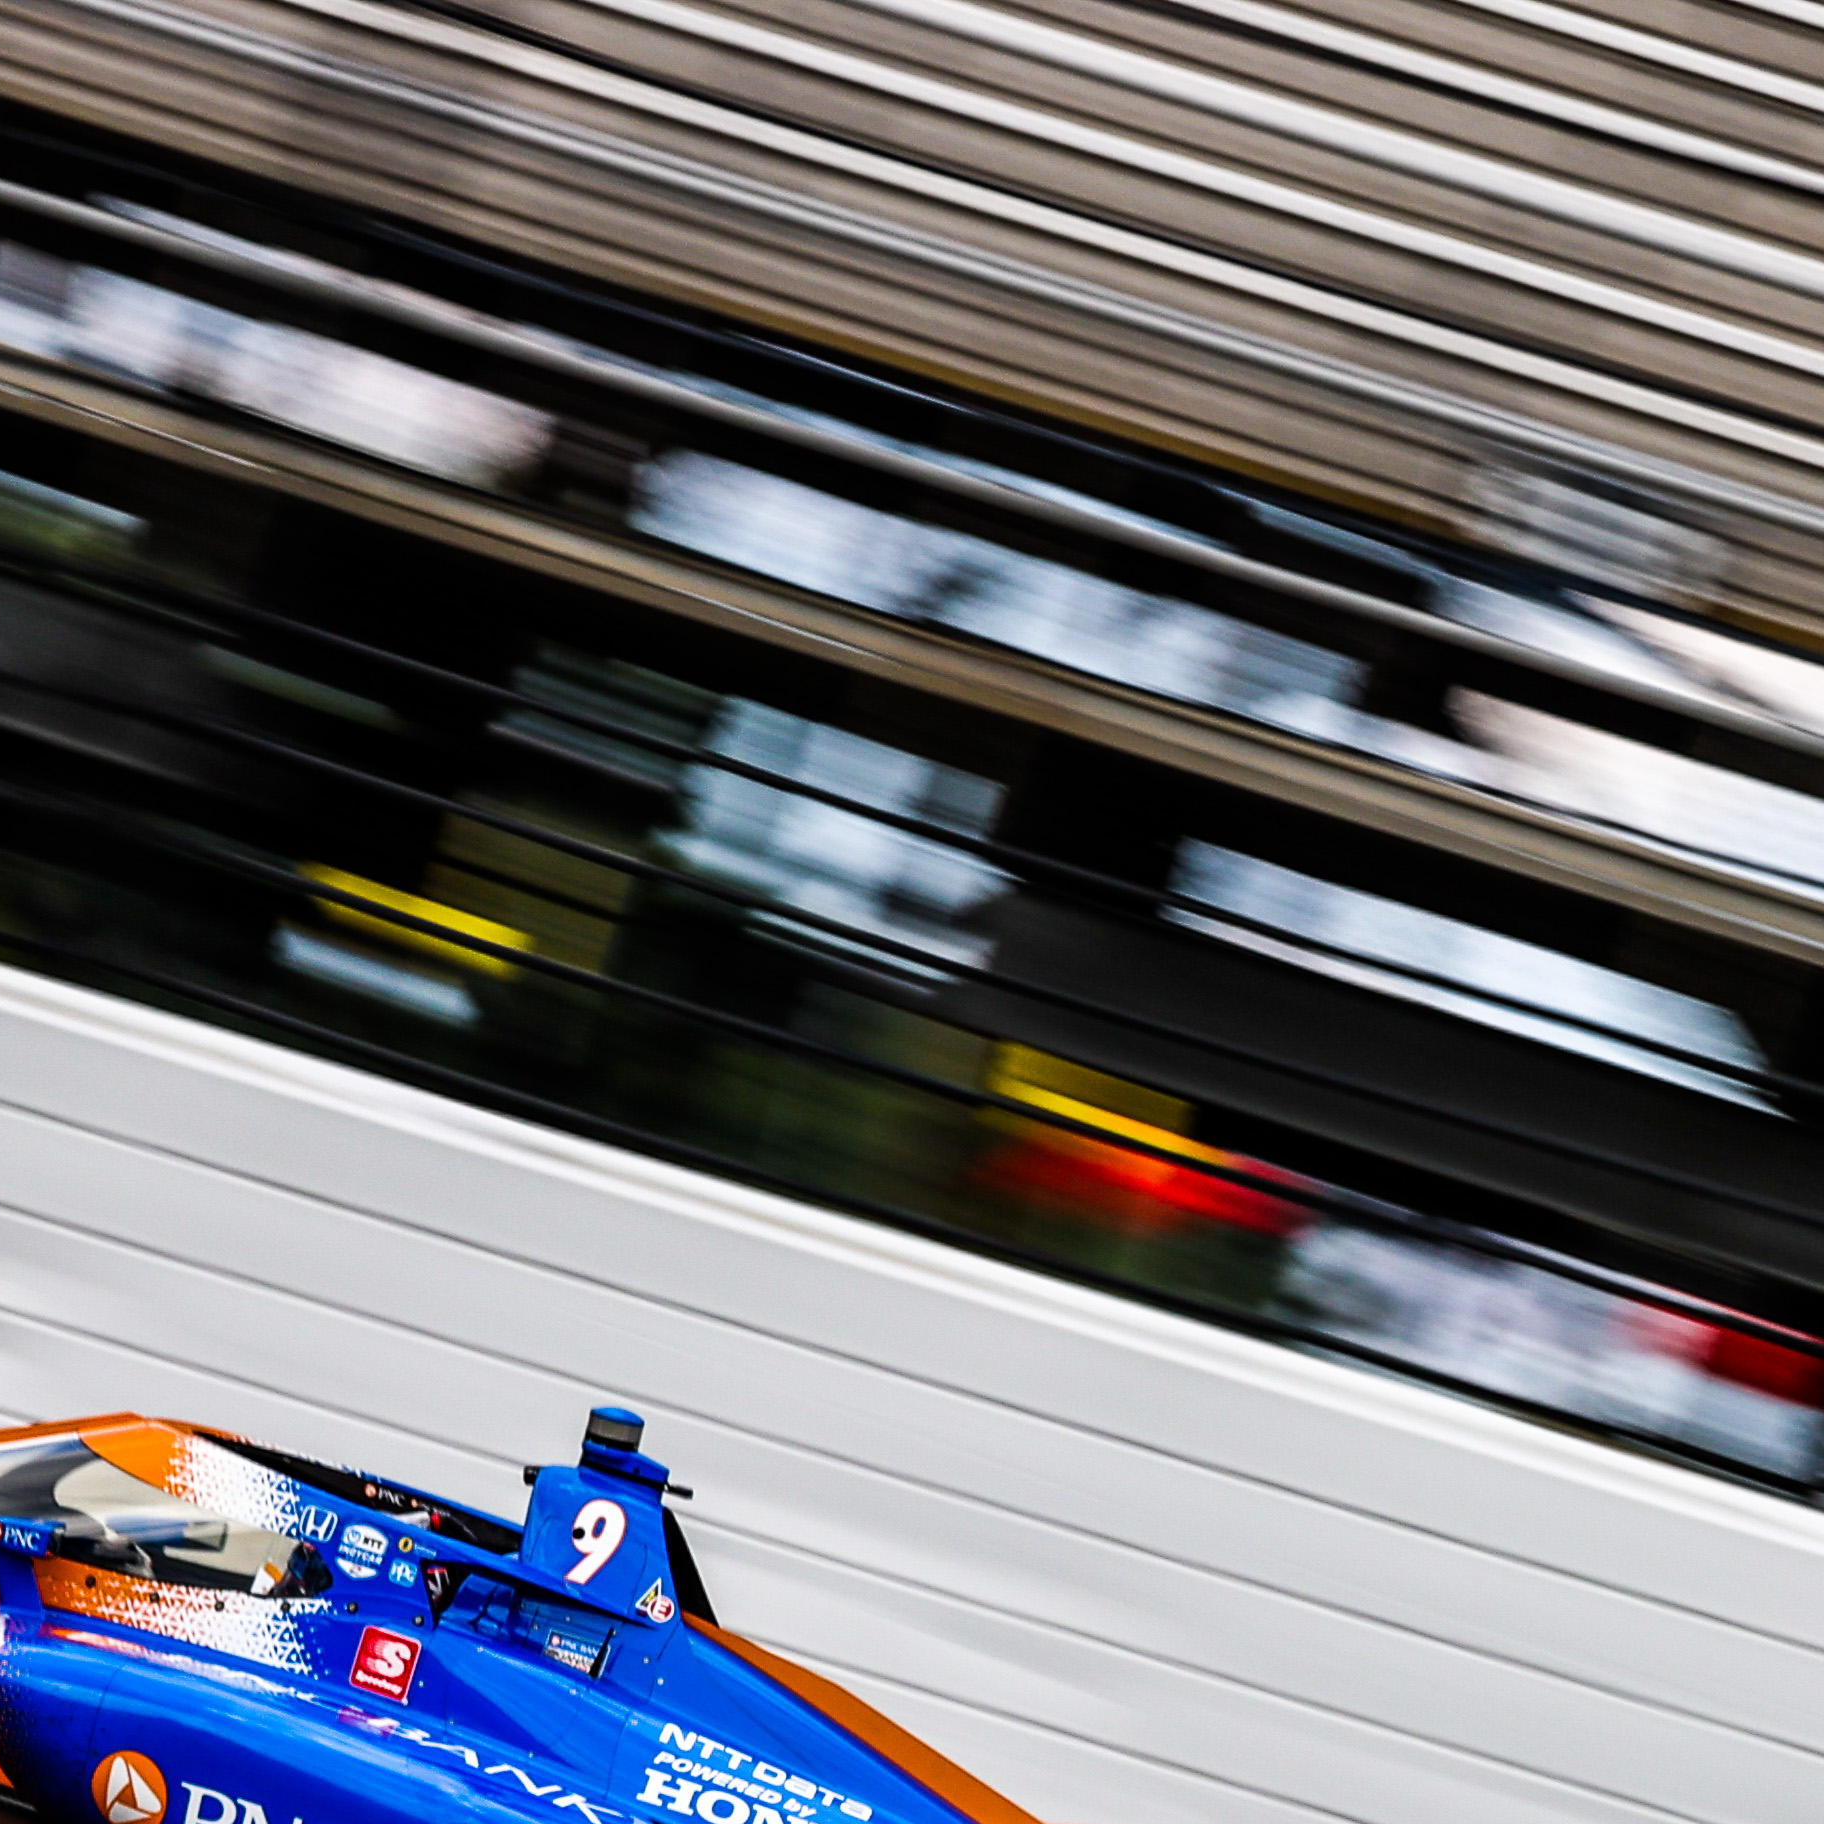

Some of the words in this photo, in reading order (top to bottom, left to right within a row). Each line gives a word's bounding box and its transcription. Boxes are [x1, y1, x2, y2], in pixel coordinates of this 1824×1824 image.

[4, 1524, 41, 1551] PNC
[362, 1536, 383, 1550] NTT
[564, 1498, 627, 1585] 9
[659, 1722, 753, 1771] NTT
[653, 1751, 783, 1805] POWERED
[782, 1797, 817, 1819] by
